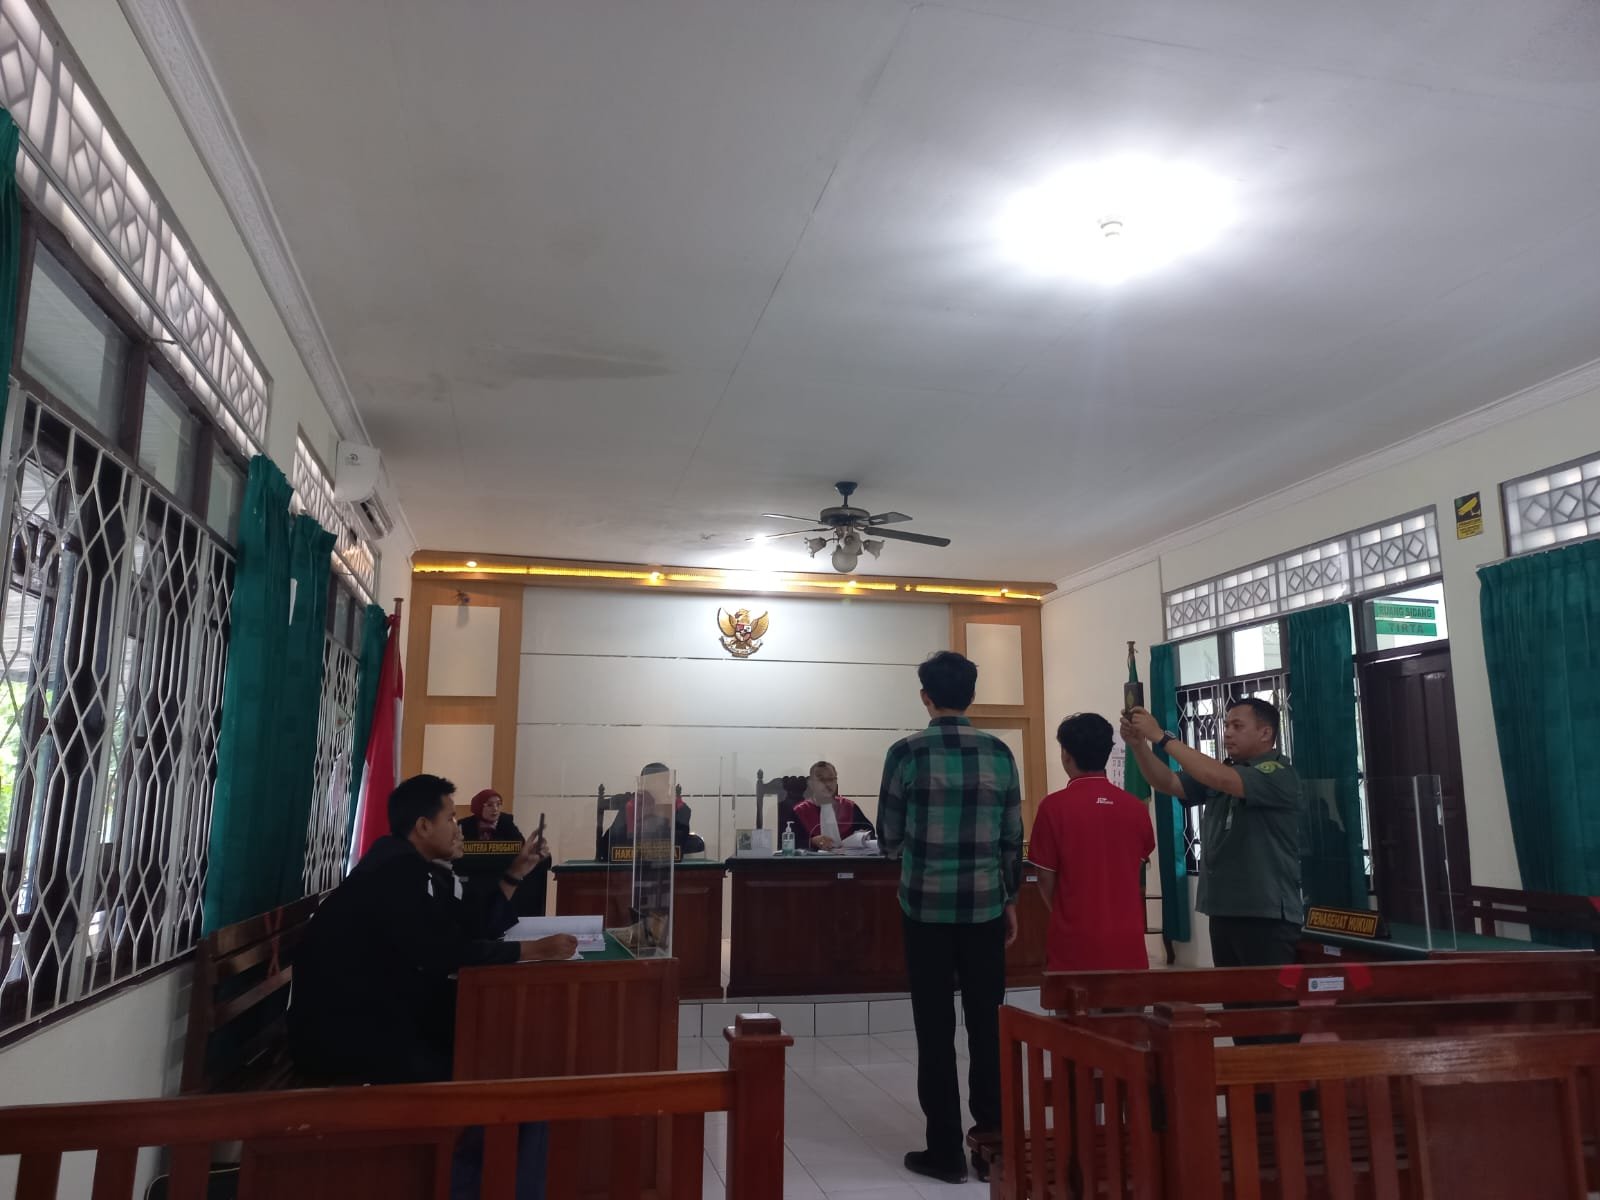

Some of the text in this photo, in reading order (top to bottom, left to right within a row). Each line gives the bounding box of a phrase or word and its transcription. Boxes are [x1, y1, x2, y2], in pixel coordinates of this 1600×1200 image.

[1378, 606, 1432, 618] RUANG SIDANG
[1389, 623, 1424, 633] TIRTA
[464, 843, 520, 853] ANITERA PENGGANTI
[1311, 911, 1374, 933] PENASEHAT HUKUM
